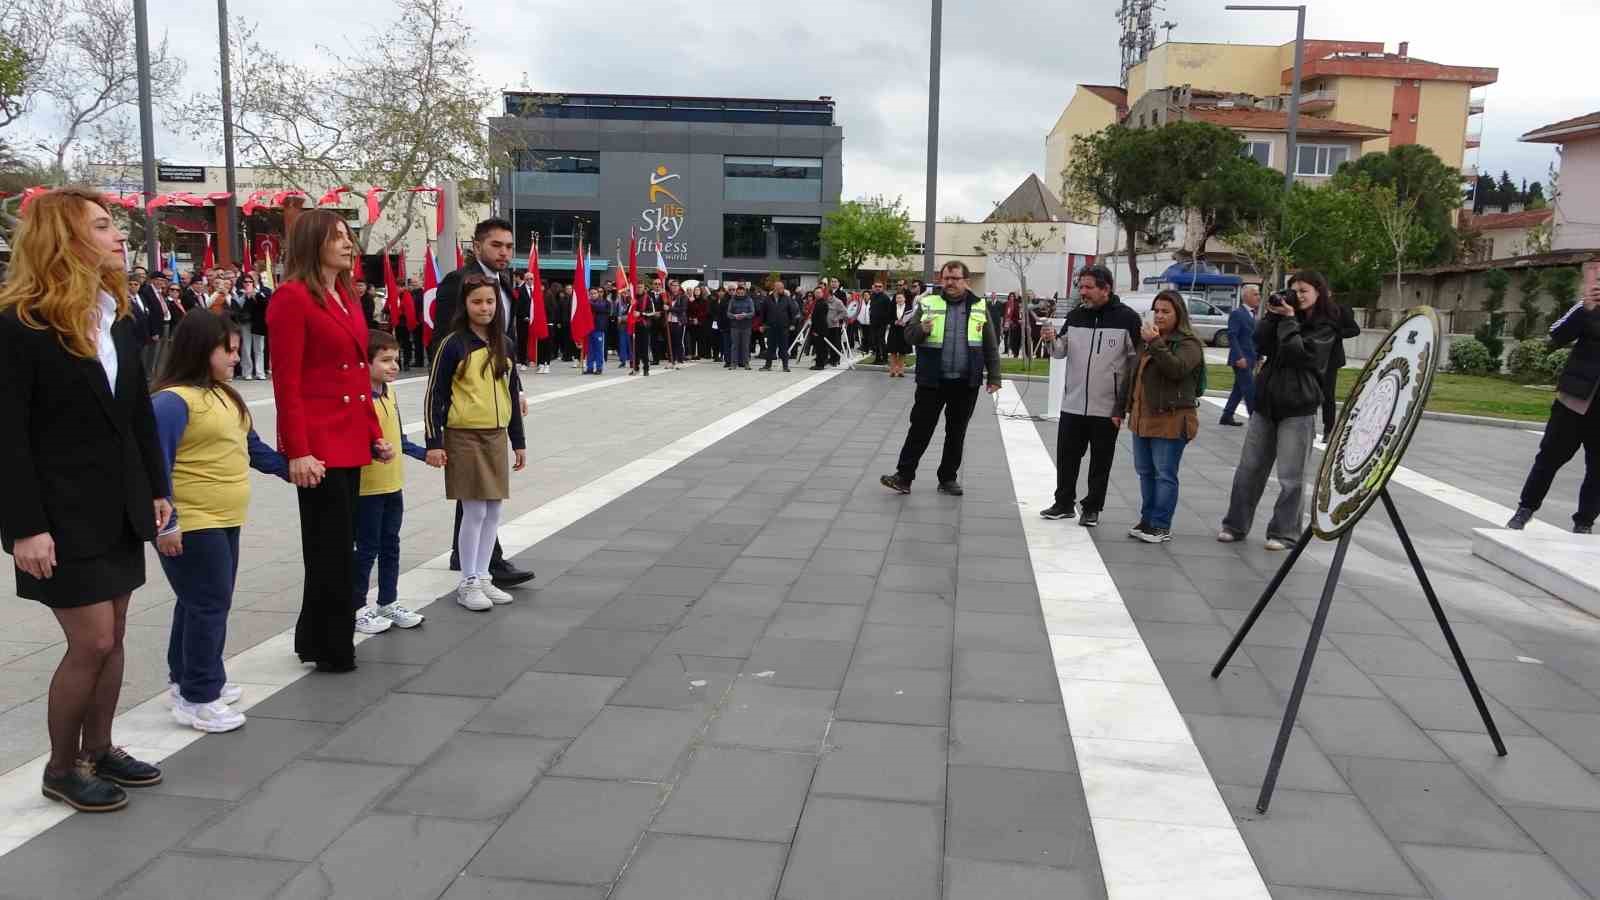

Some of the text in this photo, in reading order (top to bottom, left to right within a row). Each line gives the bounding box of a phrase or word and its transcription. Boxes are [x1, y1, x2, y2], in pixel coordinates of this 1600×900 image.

[663, 204, 684, 217] life
[640, 208, 684, 239] Sky
[635, 237, 688, 256] fitness
